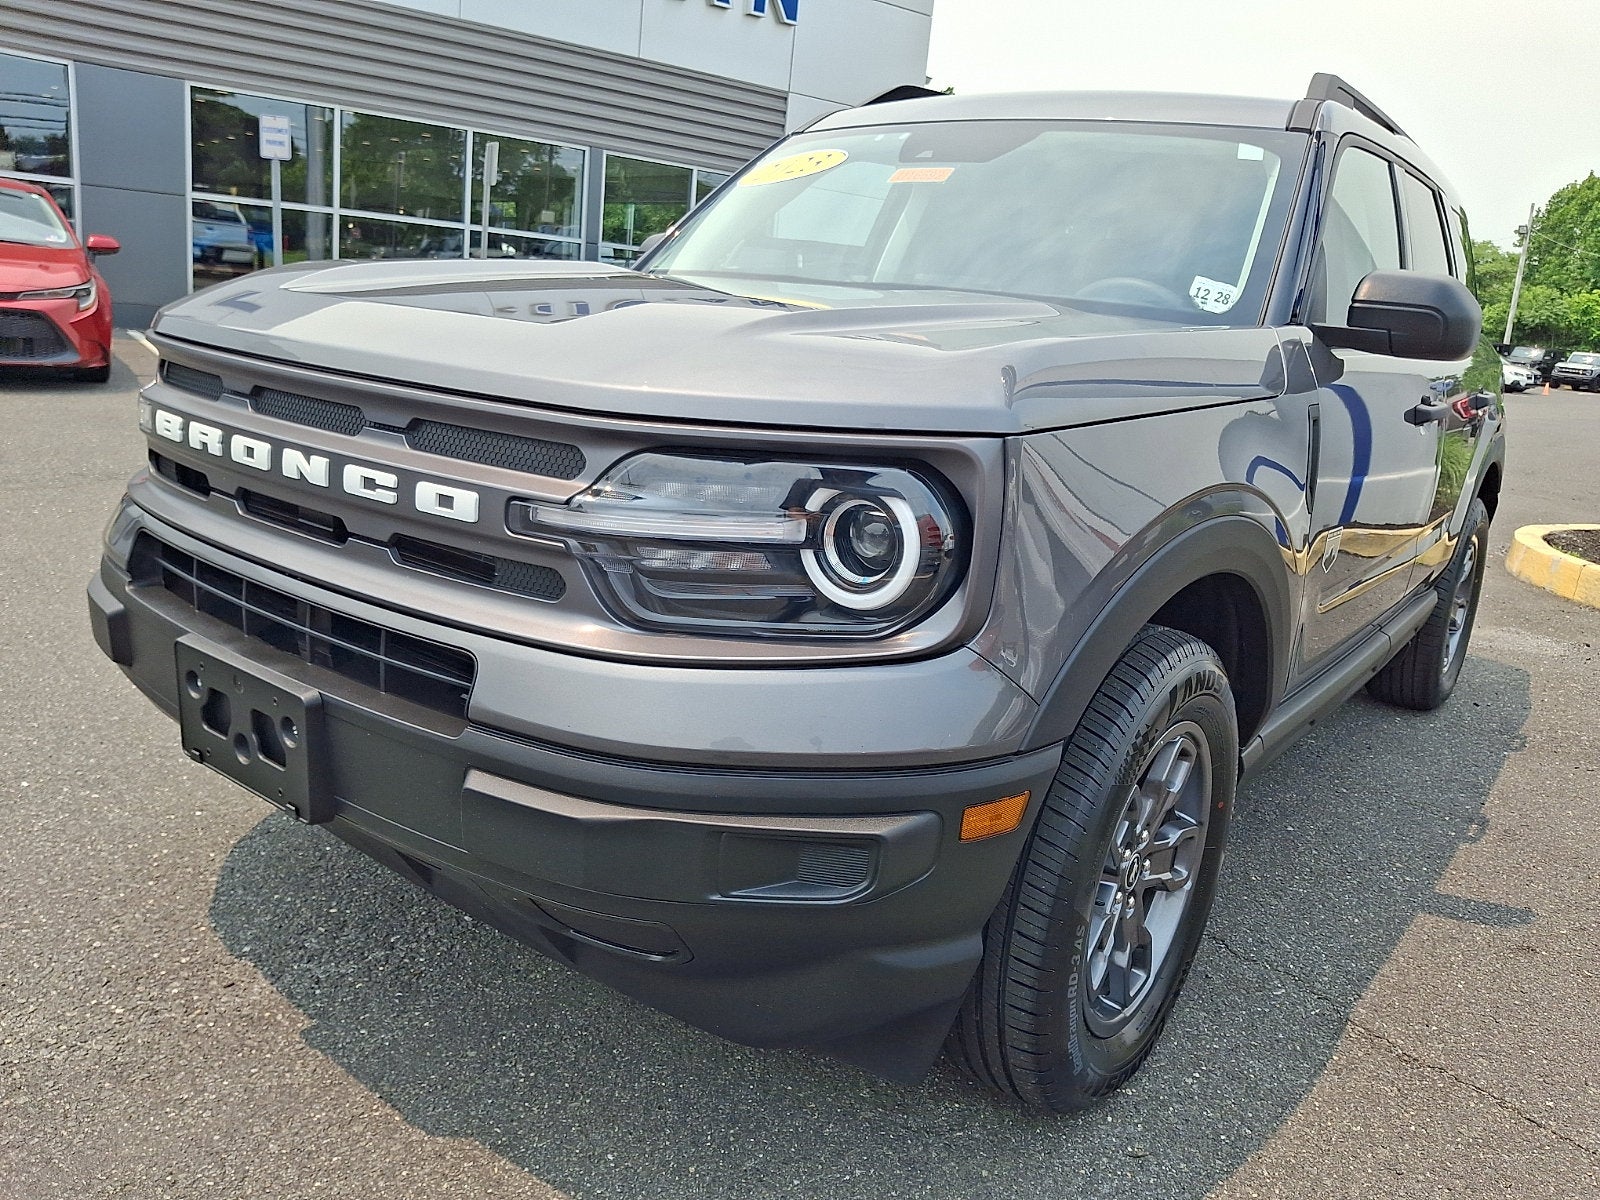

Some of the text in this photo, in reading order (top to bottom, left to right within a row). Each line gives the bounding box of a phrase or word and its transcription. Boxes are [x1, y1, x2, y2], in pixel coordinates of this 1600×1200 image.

[1193, 286, 1231, 305] 12 28
[155, 409, 480, 524] BRONCO
[1067, 954, 1081, 998] RD-3
[1074, 924, 1086, 951] AS
